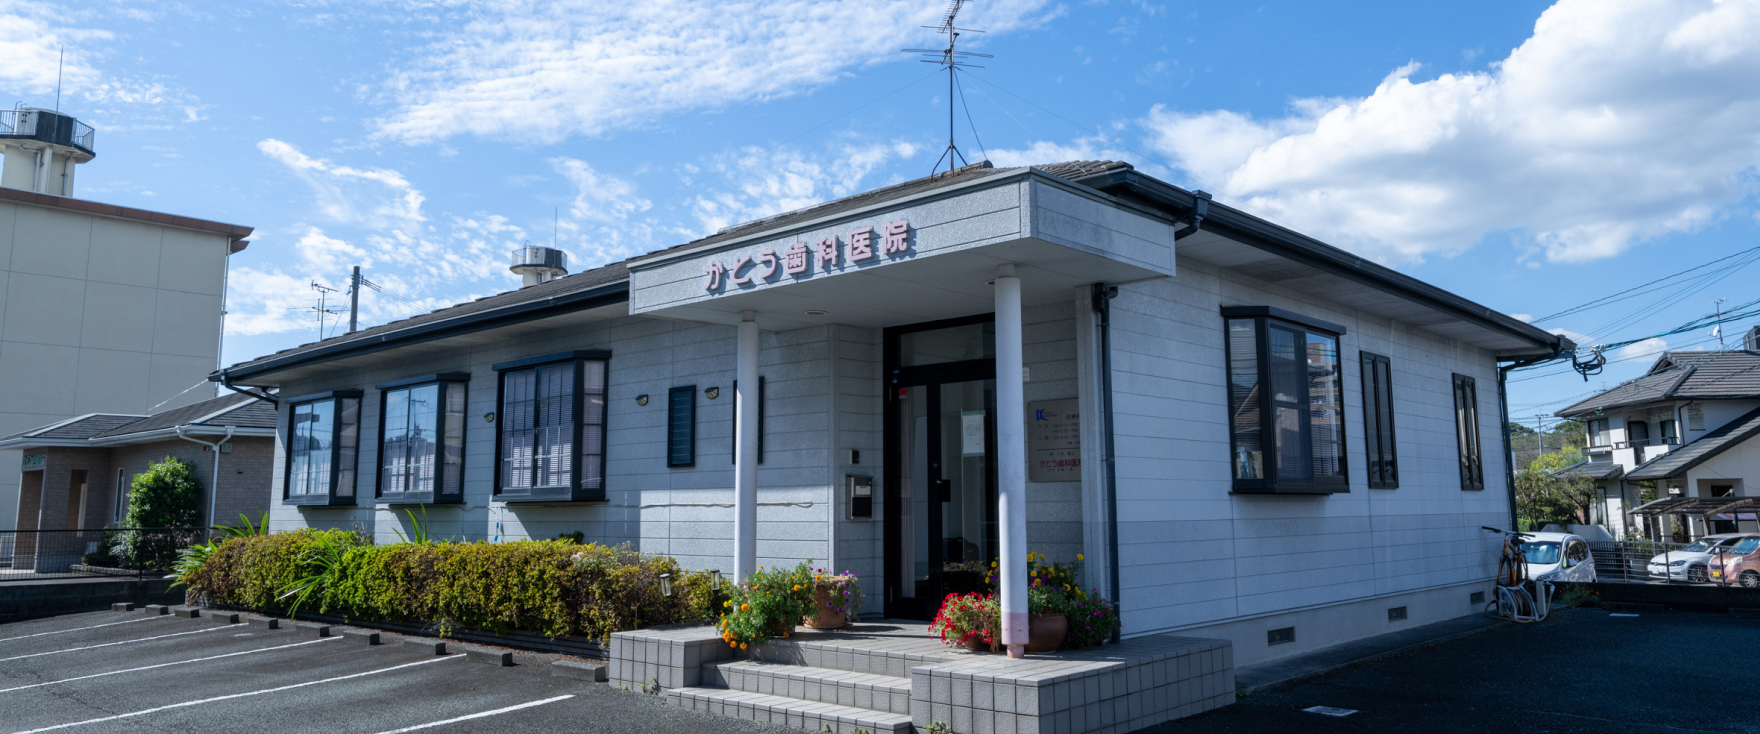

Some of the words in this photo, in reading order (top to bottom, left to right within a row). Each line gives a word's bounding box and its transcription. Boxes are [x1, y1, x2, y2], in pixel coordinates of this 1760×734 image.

[705, 219, 910, 291] かとう歯科医院
